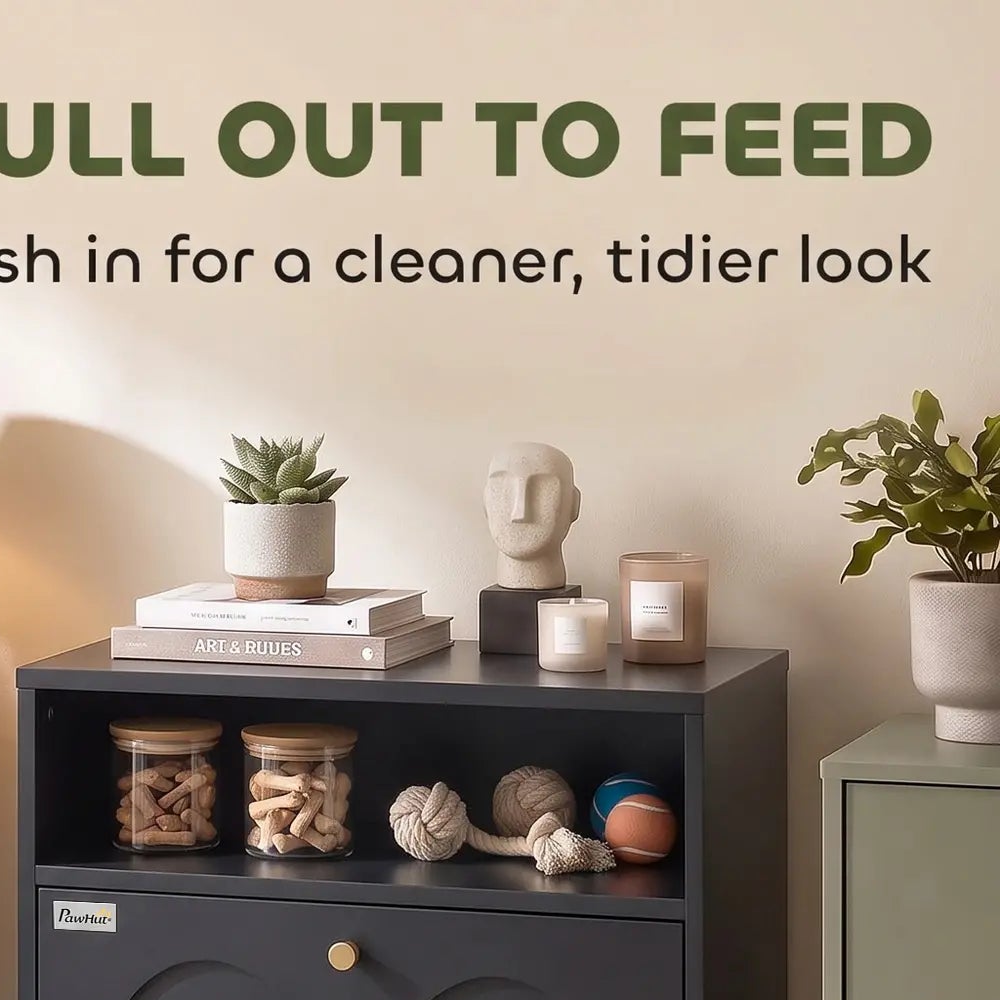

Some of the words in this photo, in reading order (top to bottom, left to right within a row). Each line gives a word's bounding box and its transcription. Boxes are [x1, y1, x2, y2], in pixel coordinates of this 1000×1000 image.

[194, 638, 226, 654] ART
[229, 640, 241, 655] &
[58, 908, 108, 925] PawHut
